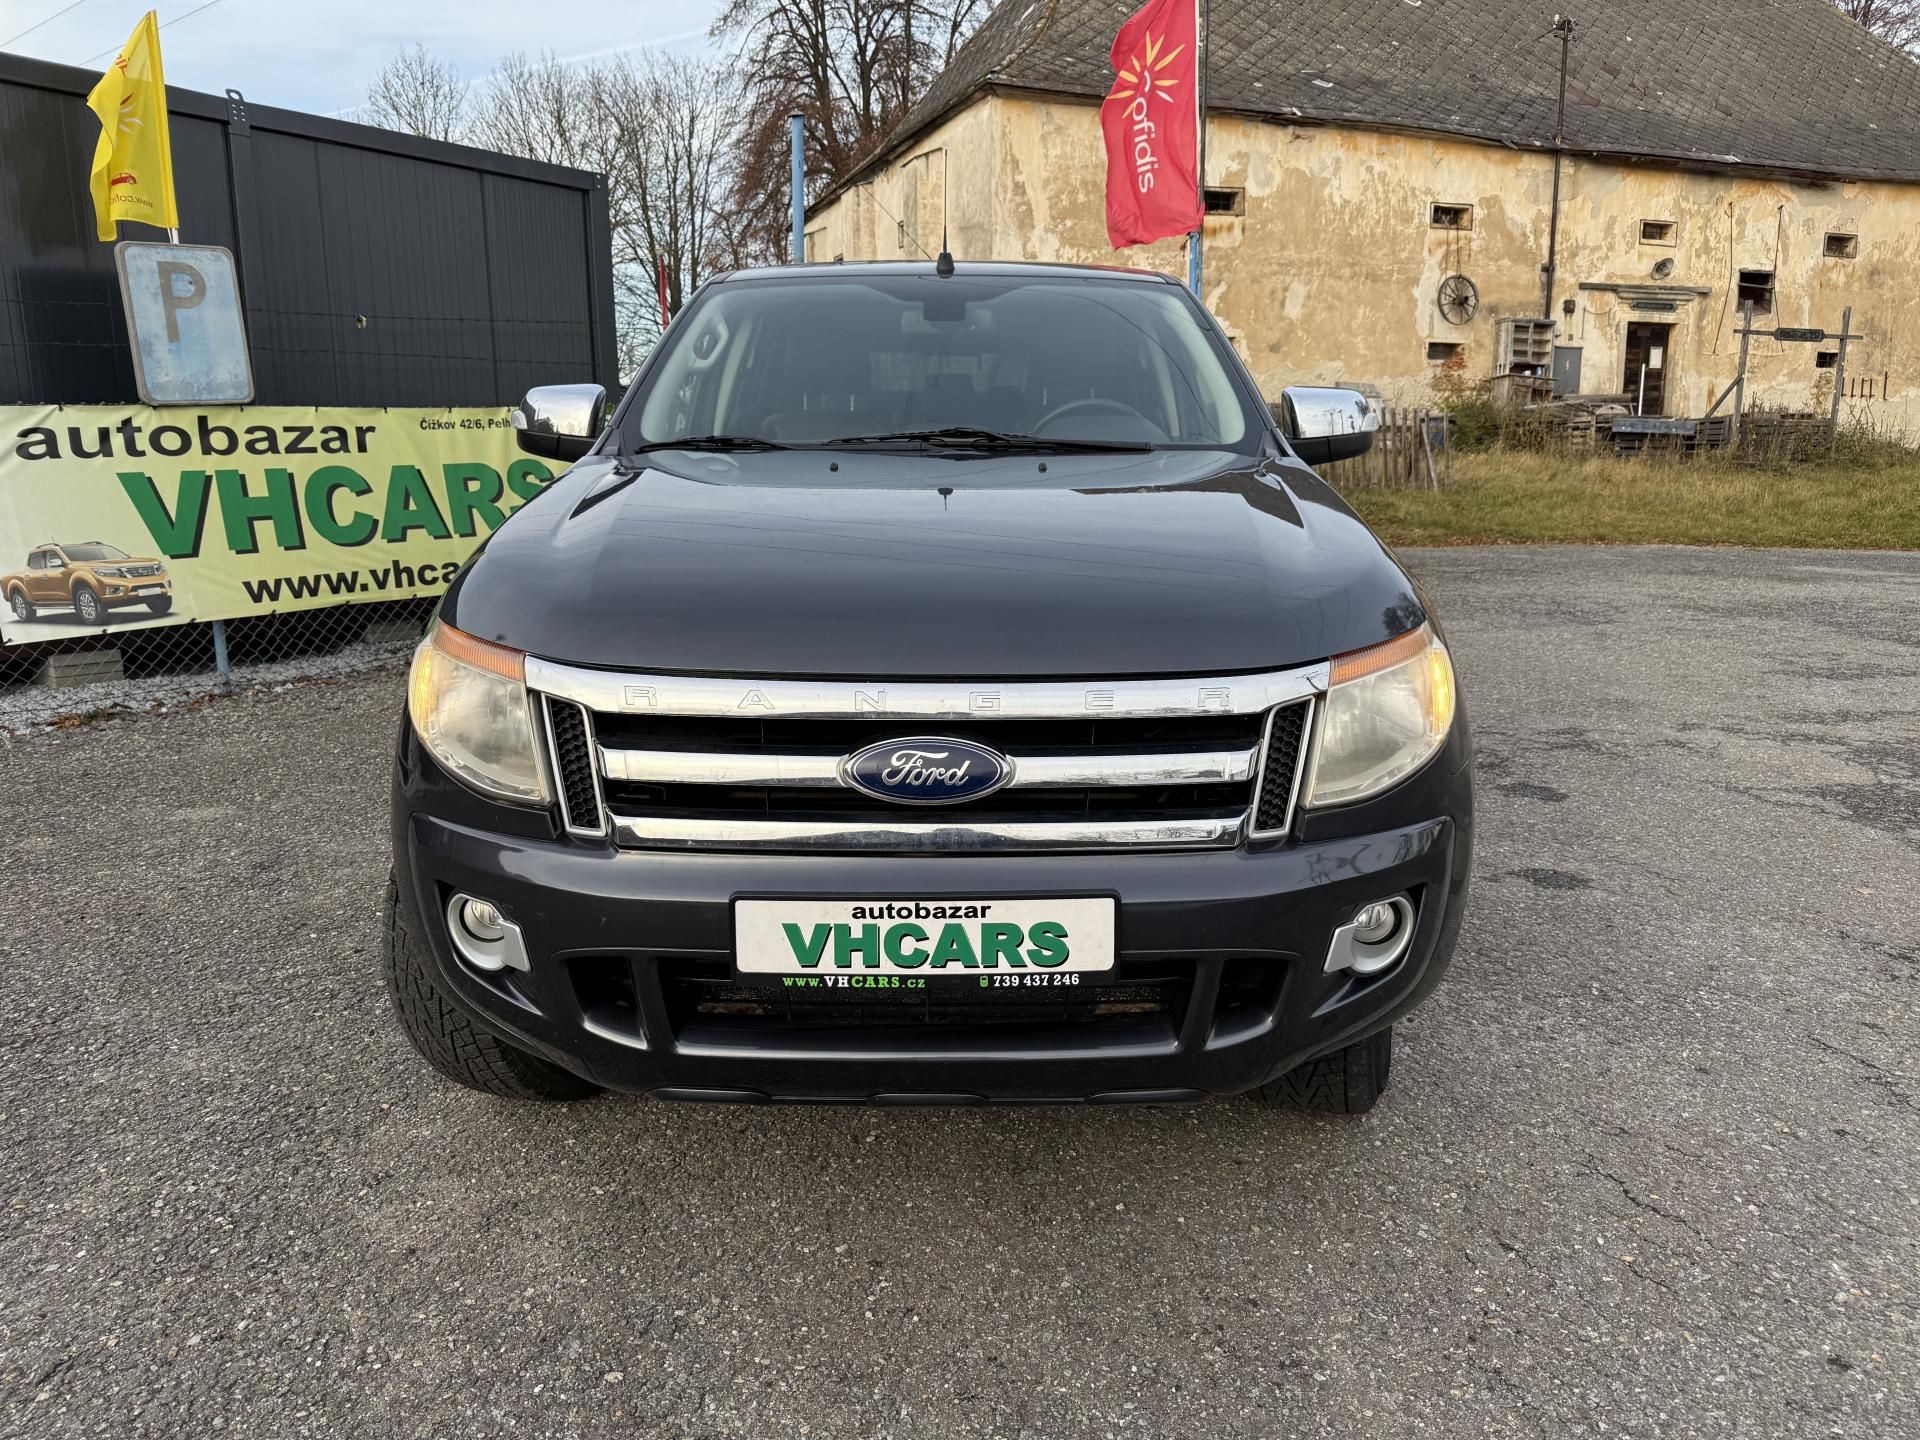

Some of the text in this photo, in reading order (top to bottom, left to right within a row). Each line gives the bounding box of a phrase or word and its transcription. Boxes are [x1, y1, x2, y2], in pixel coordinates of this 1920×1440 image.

[156, 260, 206, 343] P
[15, 415, 376, 460] autobazar
[460, 418, 485, 431] 42/6,
[116, 458, 555, 559] VHCARS
[623, 684, 1232, 711] RANGER
[881, 750, 969, 787] Ford
[851, 902, 991, 919] autobazar
[781, 921, 1070, 969] VHCARS
[782, 975, 926, 988] www.VHCARS.cz
[993, 973, 1080, 987] 739 437 246
